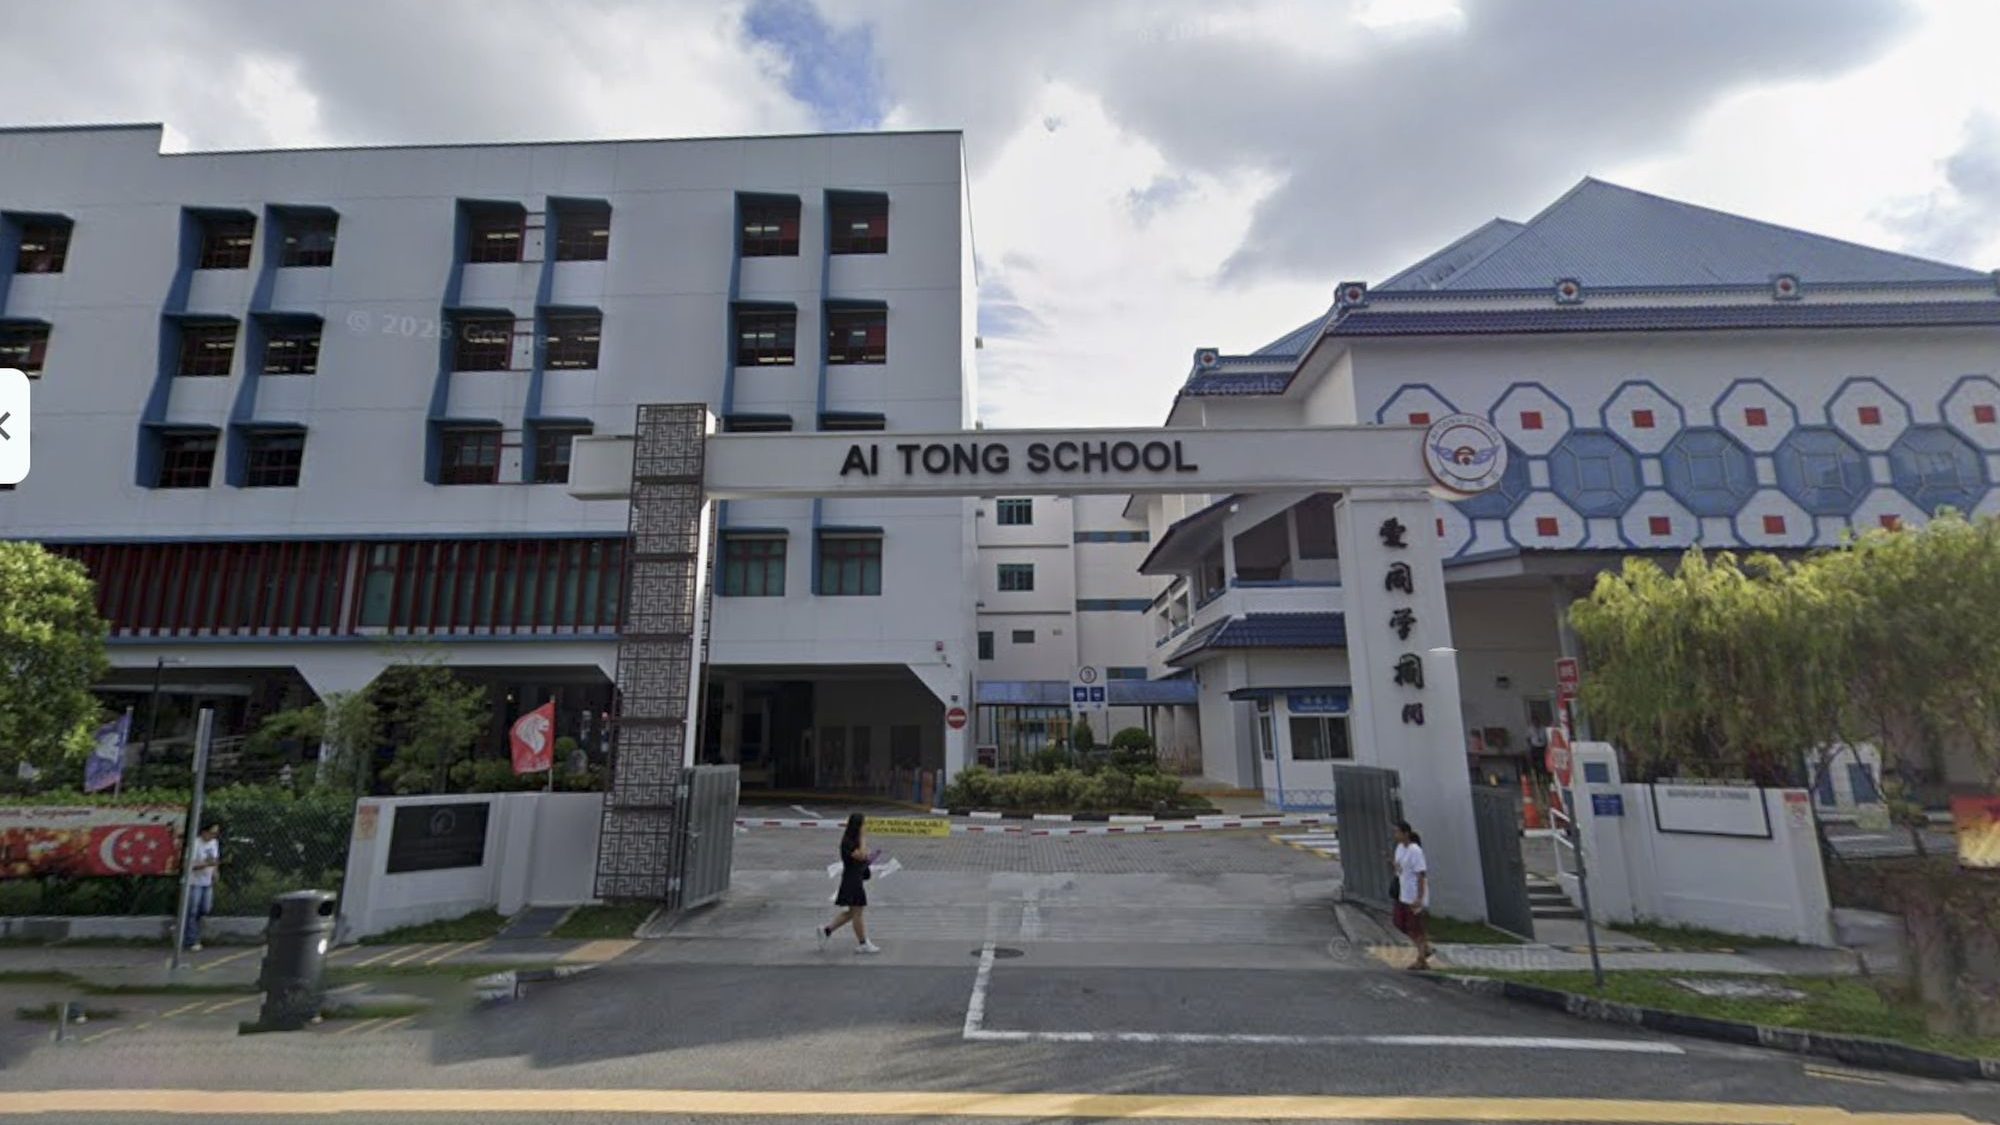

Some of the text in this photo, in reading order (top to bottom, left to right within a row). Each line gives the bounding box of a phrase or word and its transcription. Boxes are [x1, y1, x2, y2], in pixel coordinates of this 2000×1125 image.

[840, 440, 1199, 477] AI TONG SCHOOL
